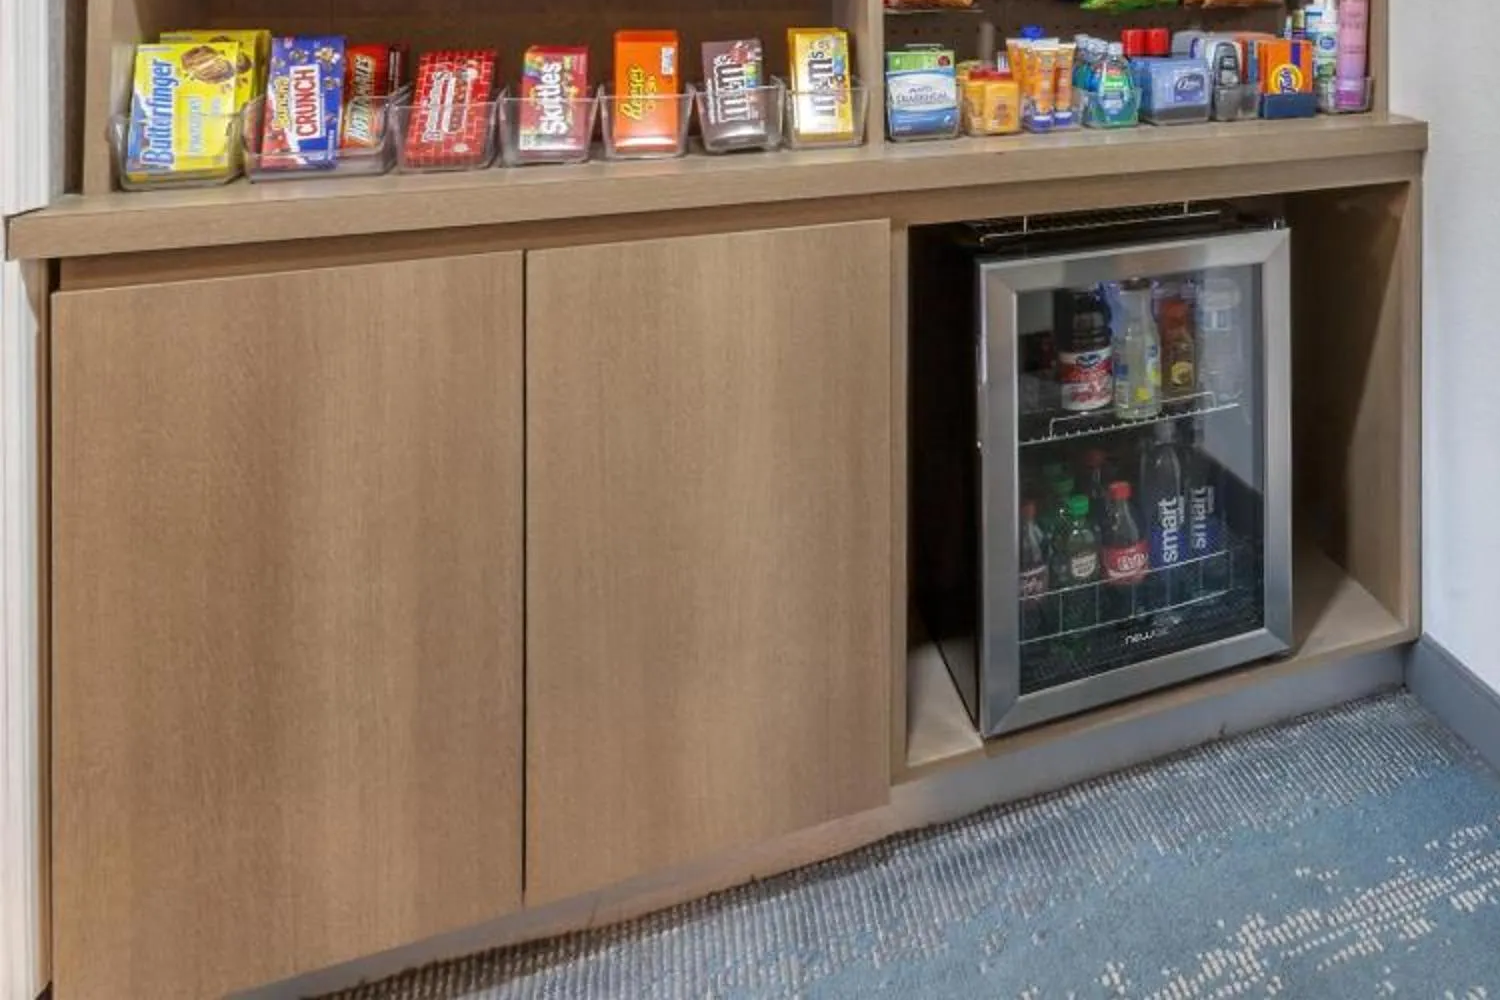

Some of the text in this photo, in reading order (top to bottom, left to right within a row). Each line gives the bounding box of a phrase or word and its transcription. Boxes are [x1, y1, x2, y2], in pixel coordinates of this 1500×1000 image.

[140, 58, 179, 167] Butterfinger
[293, 68, 318, 138] CRUNCH
[539, 61, 567, 135] Skittles
[1157, 496, 1179, 563] smart
[1190, 486, 1207, 550] smart
